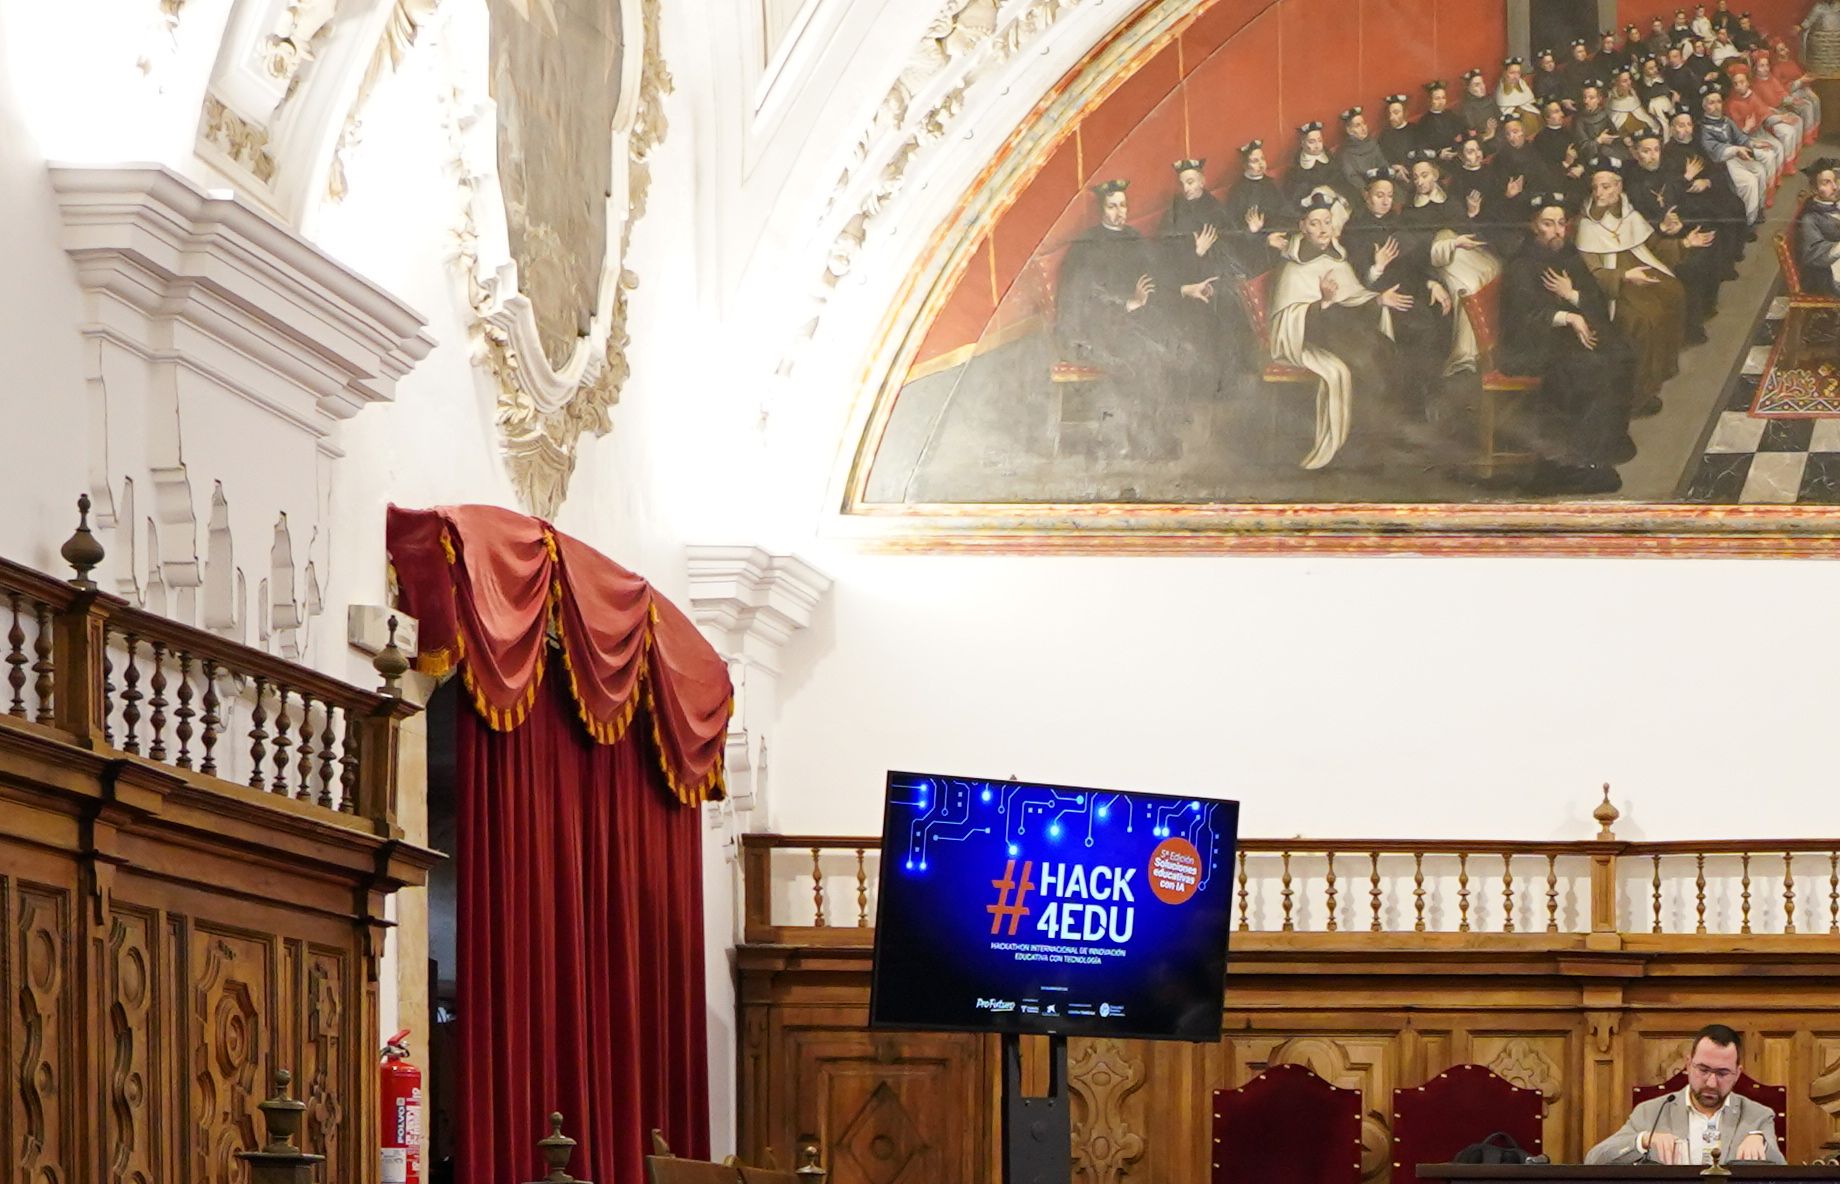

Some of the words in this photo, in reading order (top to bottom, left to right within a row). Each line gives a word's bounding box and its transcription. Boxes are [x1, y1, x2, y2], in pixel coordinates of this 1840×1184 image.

[1153, 856, 1197, 875] Soluciones
[1040, 861, 1137, 902] HACK
[1153, 868, 1195, 885] educativas
[1160, 880, 1175, 890] con
[1037, 902, 1135, 943] 4EDU
